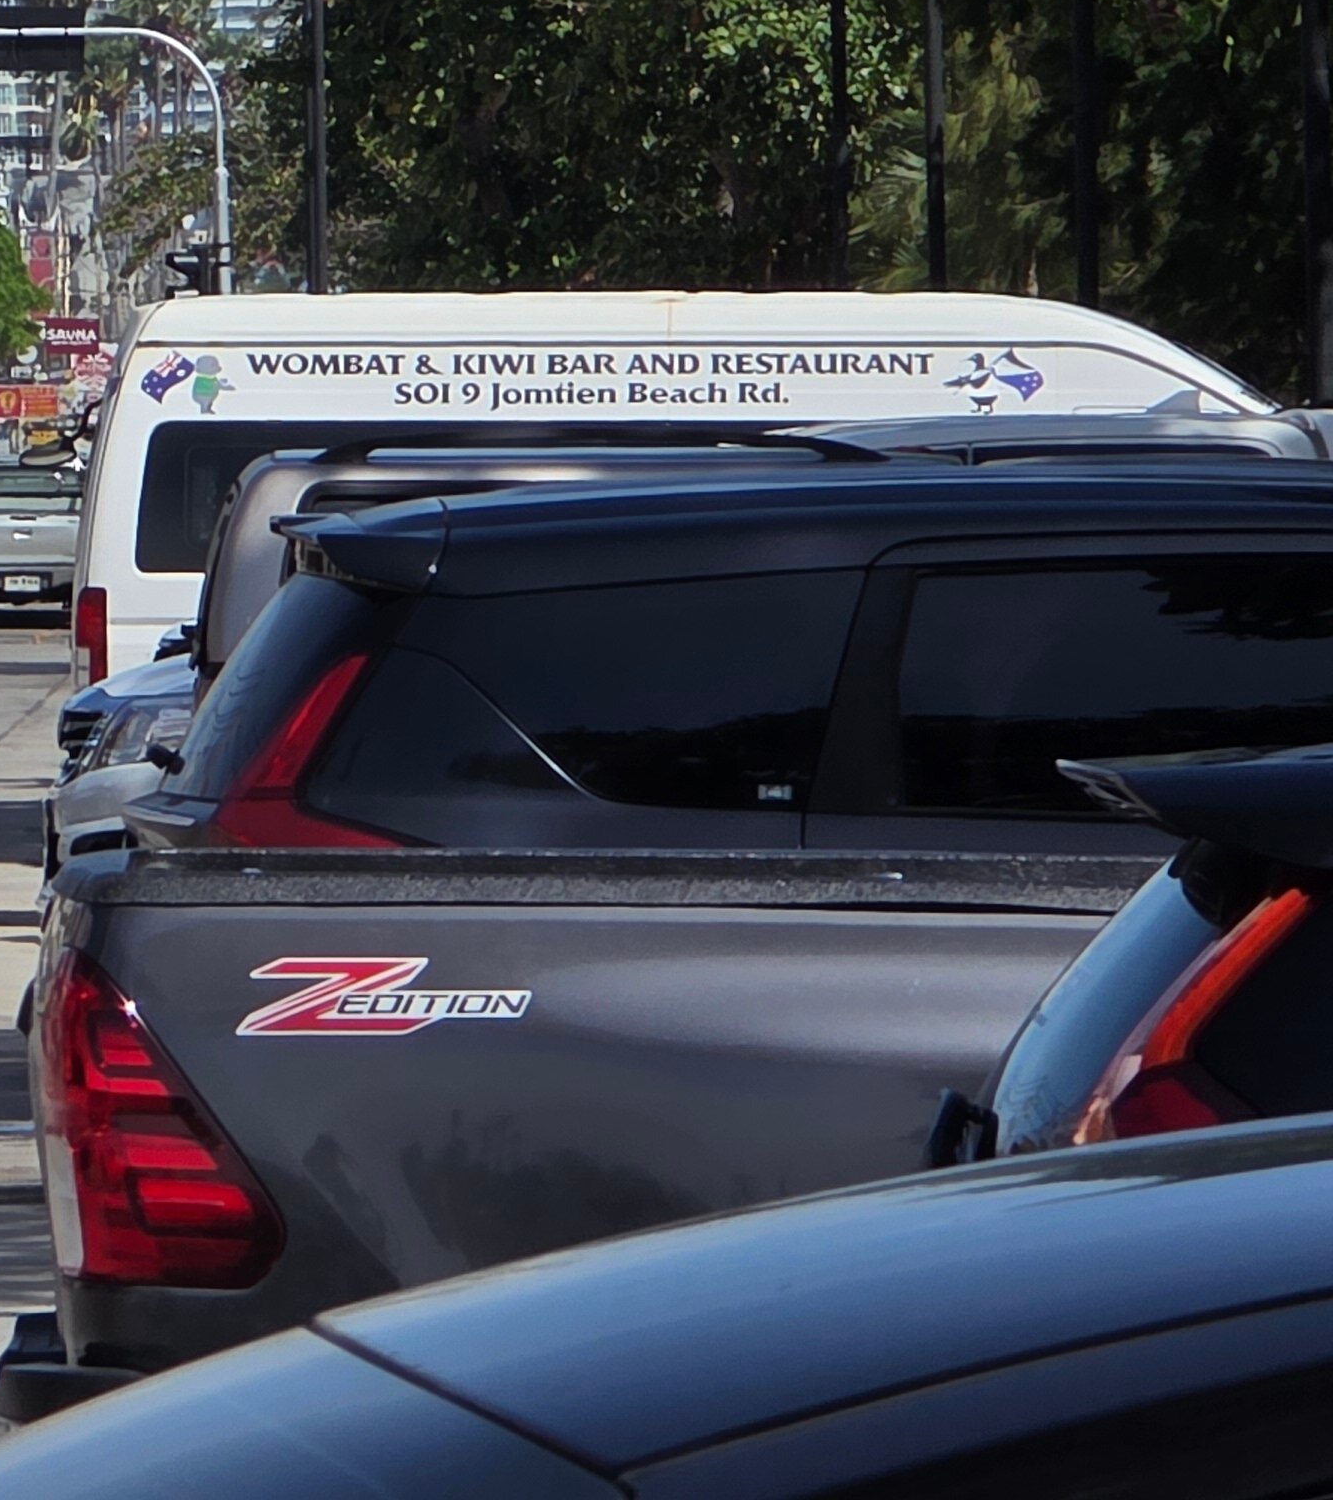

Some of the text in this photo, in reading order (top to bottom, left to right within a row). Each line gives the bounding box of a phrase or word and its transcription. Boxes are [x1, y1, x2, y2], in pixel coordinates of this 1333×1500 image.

[46, 328, 97, 341] SAUNA
[246, 353, 933, 375] WOMBAT & KIWI BAR AND RESTAURANT
[394, 382, 790, 411] SOI 9 Jomtien Beach Rd.
[235, 957, 524, 1036] Z EDITION
